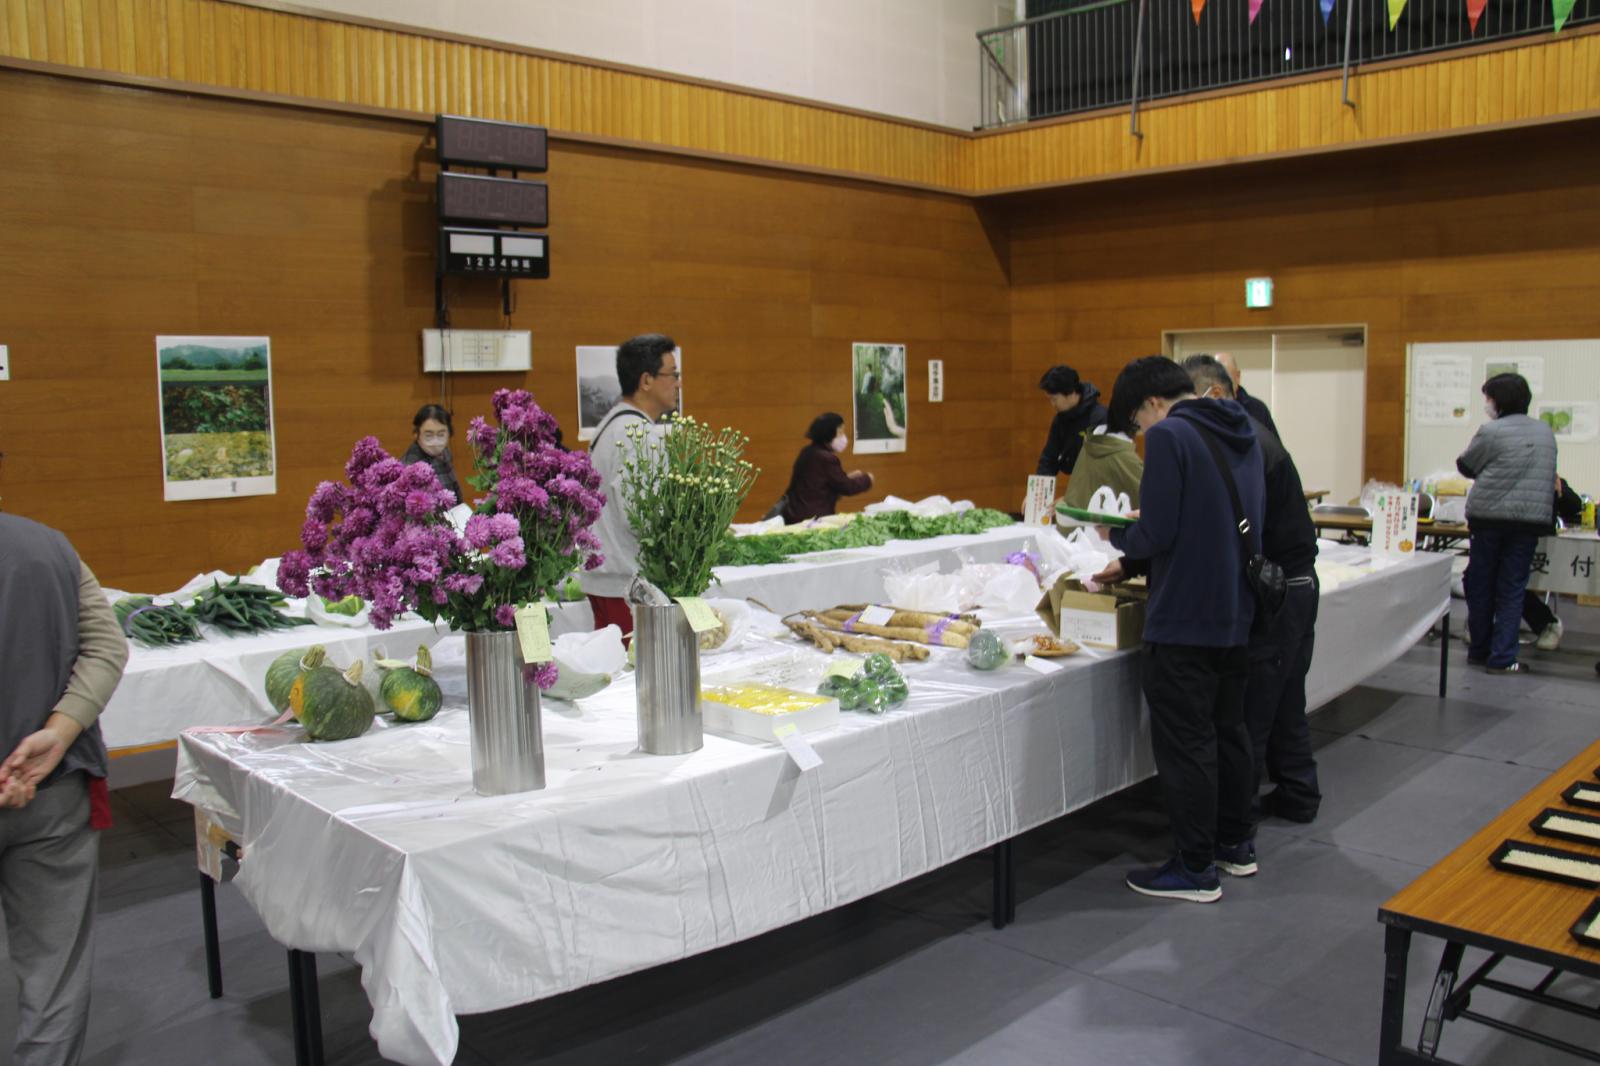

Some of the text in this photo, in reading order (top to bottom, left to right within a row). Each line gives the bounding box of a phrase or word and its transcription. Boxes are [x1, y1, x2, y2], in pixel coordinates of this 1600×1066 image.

[477, 256, 484, 267] 2
[488, 257, 495, 267] 3
[500, 258, 507, 268] 4
[1530, 552, 1595, 578] 受付
